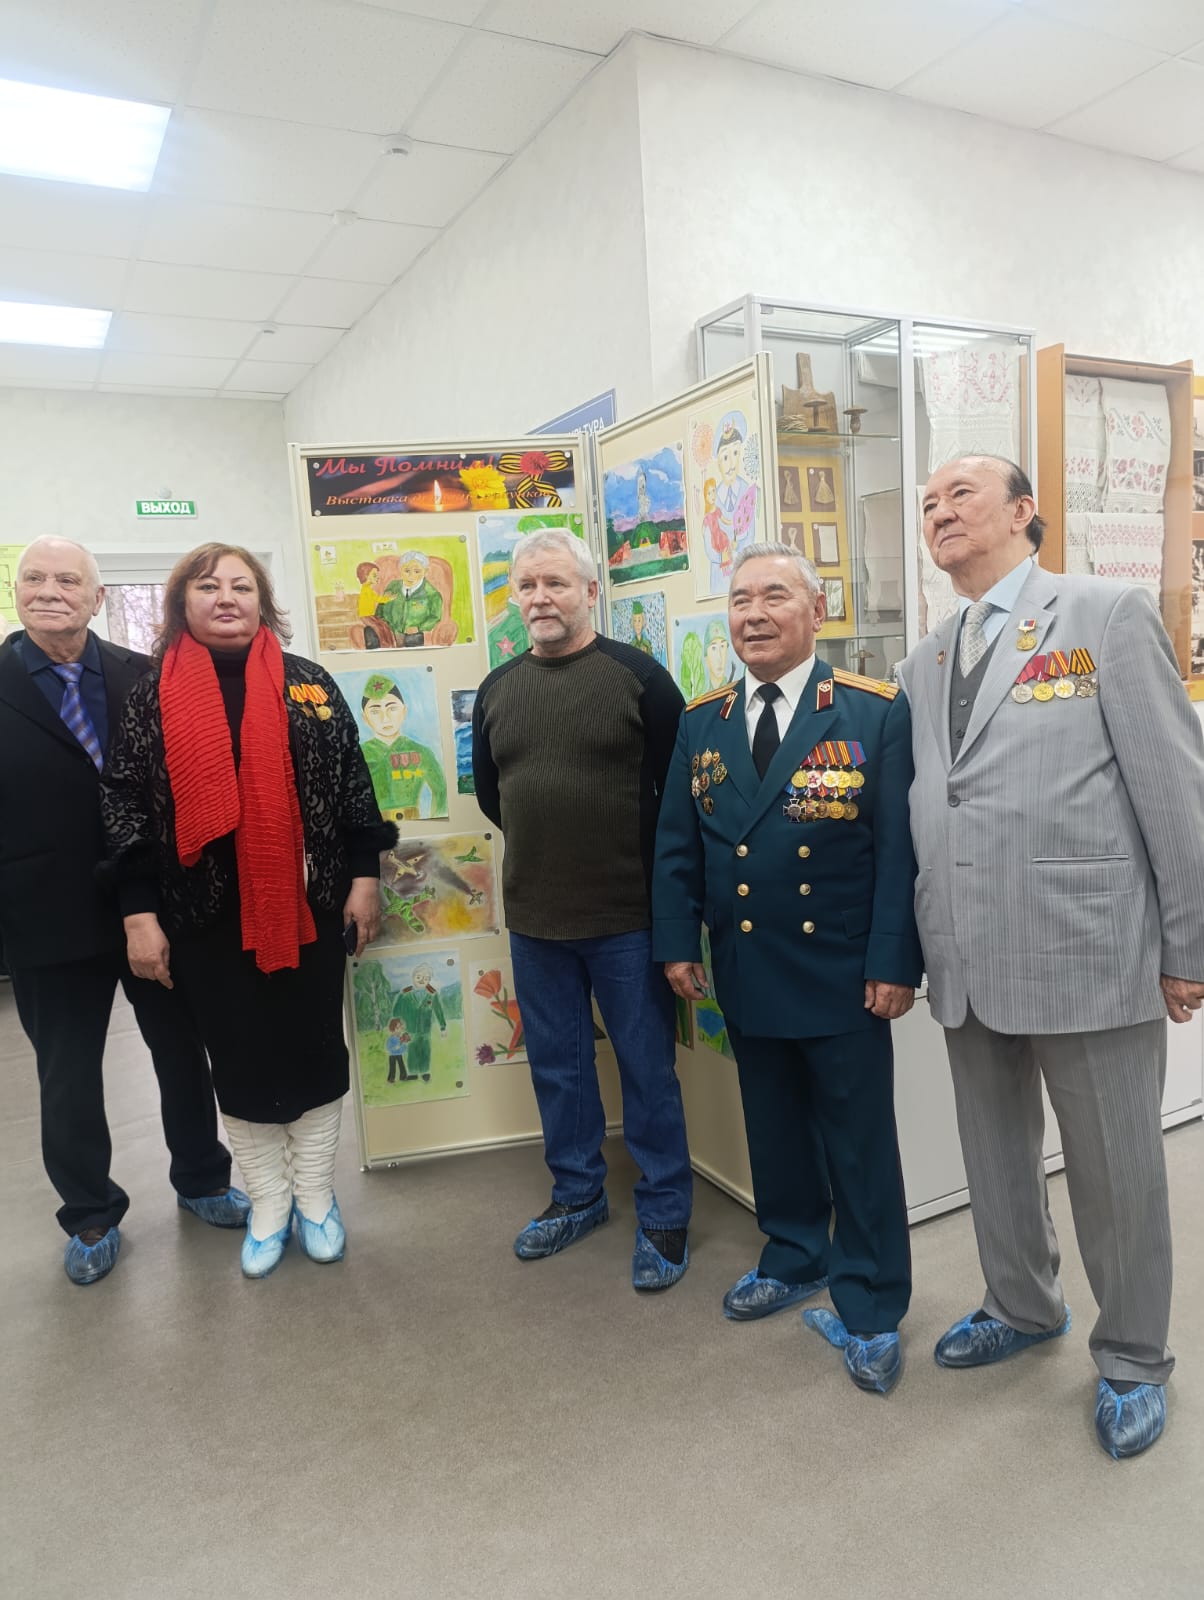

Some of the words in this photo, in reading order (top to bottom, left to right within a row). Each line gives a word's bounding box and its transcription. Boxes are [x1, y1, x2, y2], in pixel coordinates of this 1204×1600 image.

[315, 458, 366, 476] Мы
[326, 495, 408, 505] Выставка
[141, 502, 191, 513] ВЫХОД
